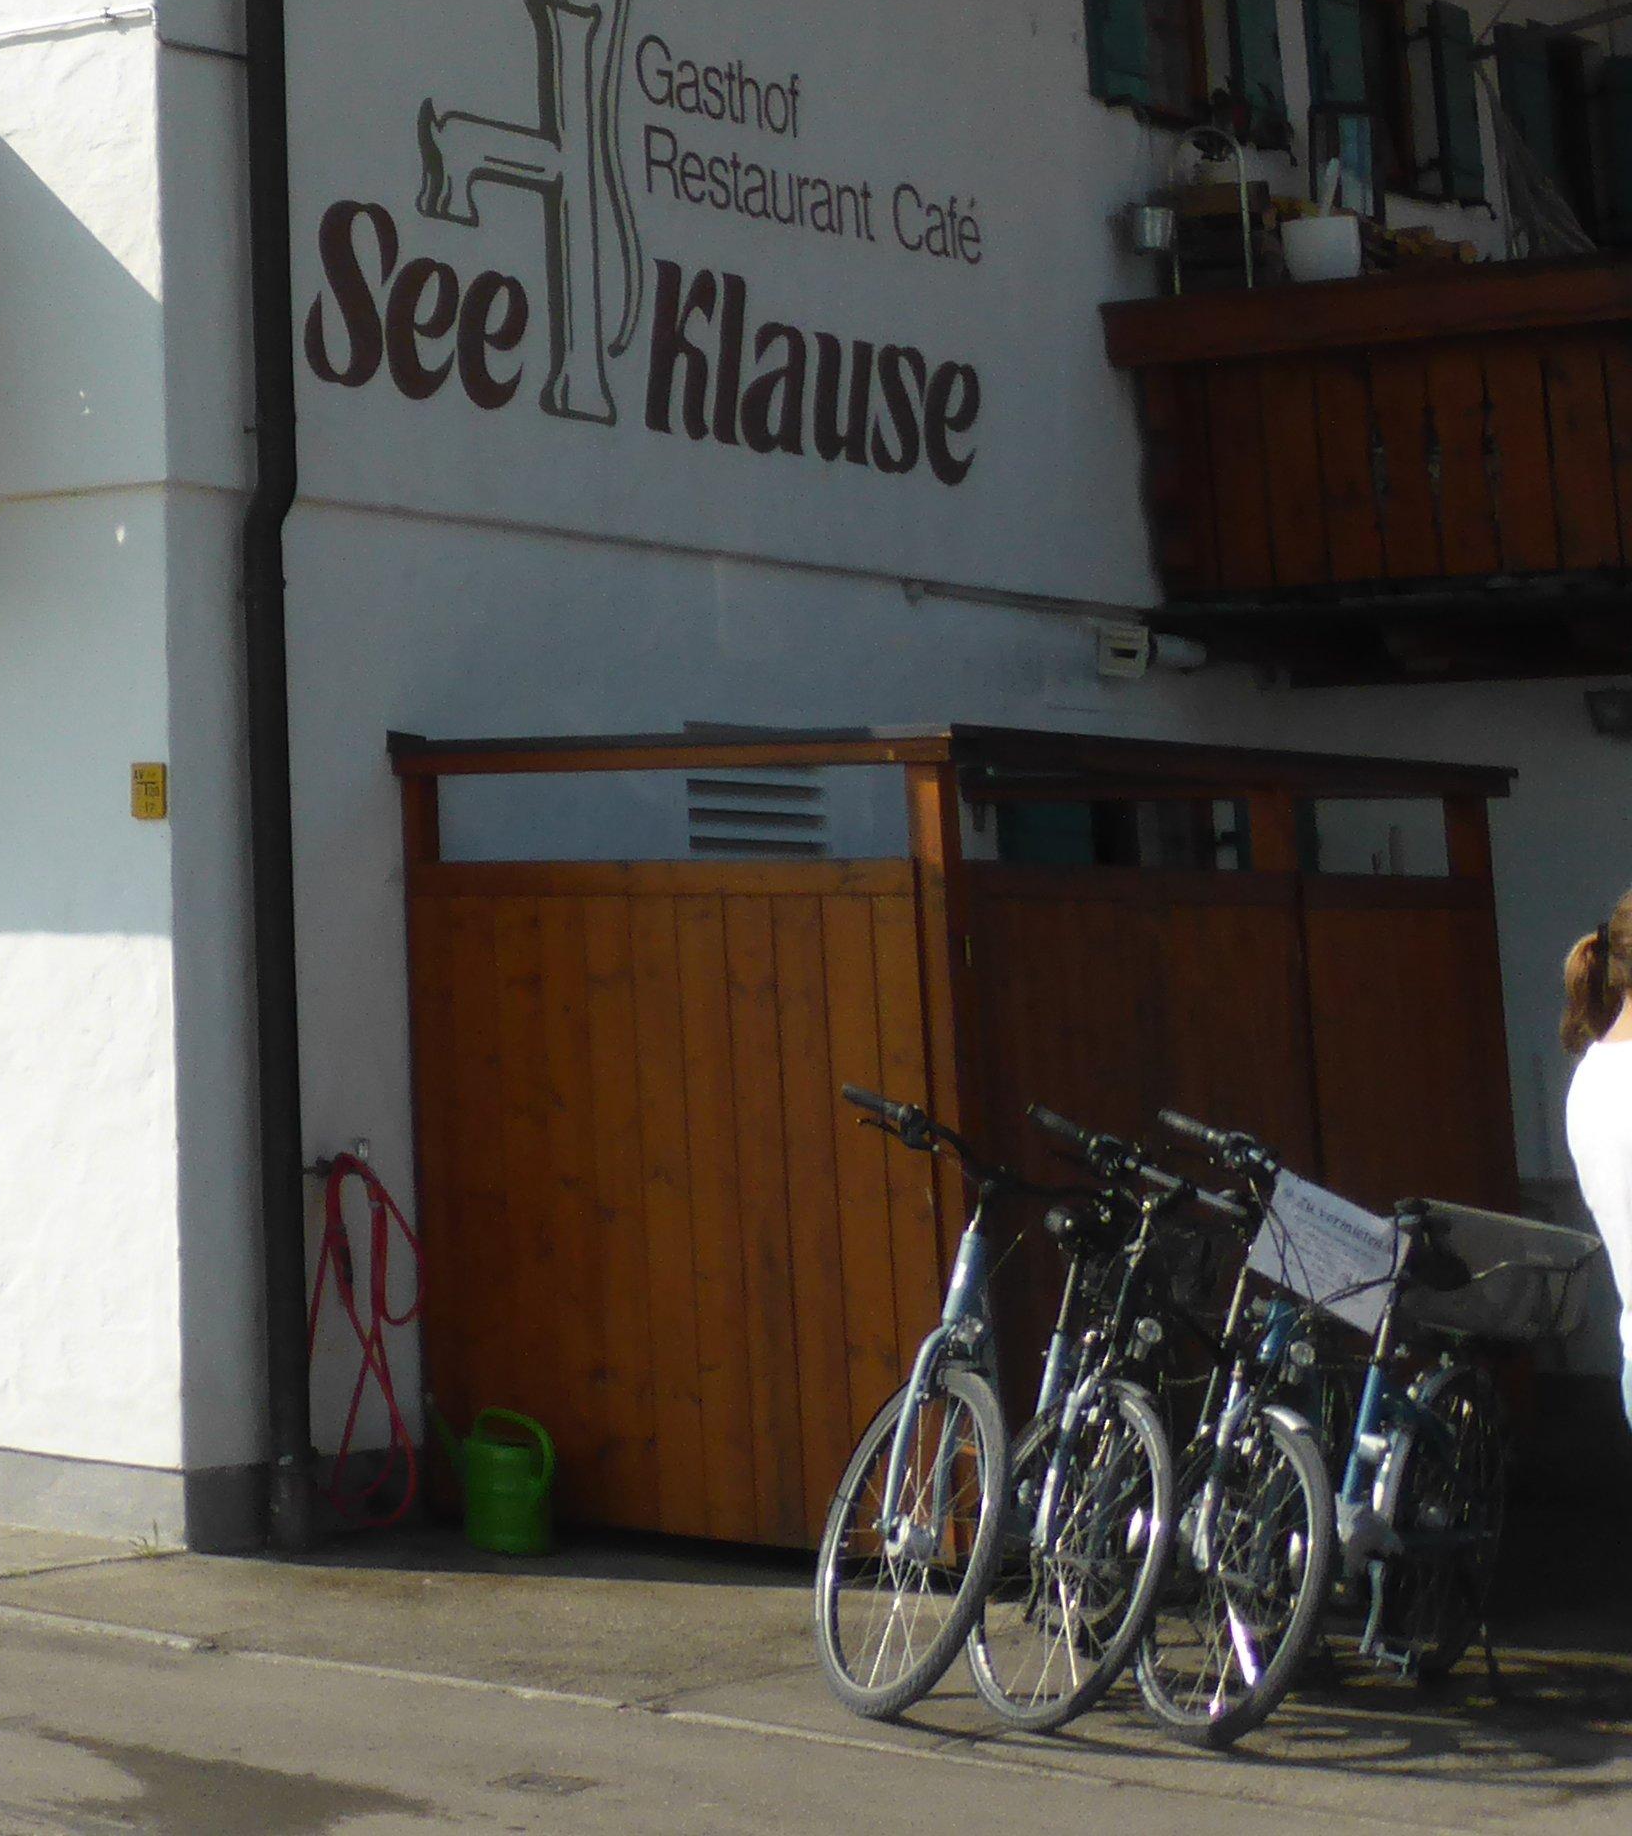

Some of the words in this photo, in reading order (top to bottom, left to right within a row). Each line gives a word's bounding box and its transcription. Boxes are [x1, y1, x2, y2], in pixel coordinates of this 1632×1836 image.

[635, 34, 803, 138] Gasthof
[644, 124, 876, 242] Restaurant
[891, 182, 984, 265] Café
[303, 199, 529, 410] See
